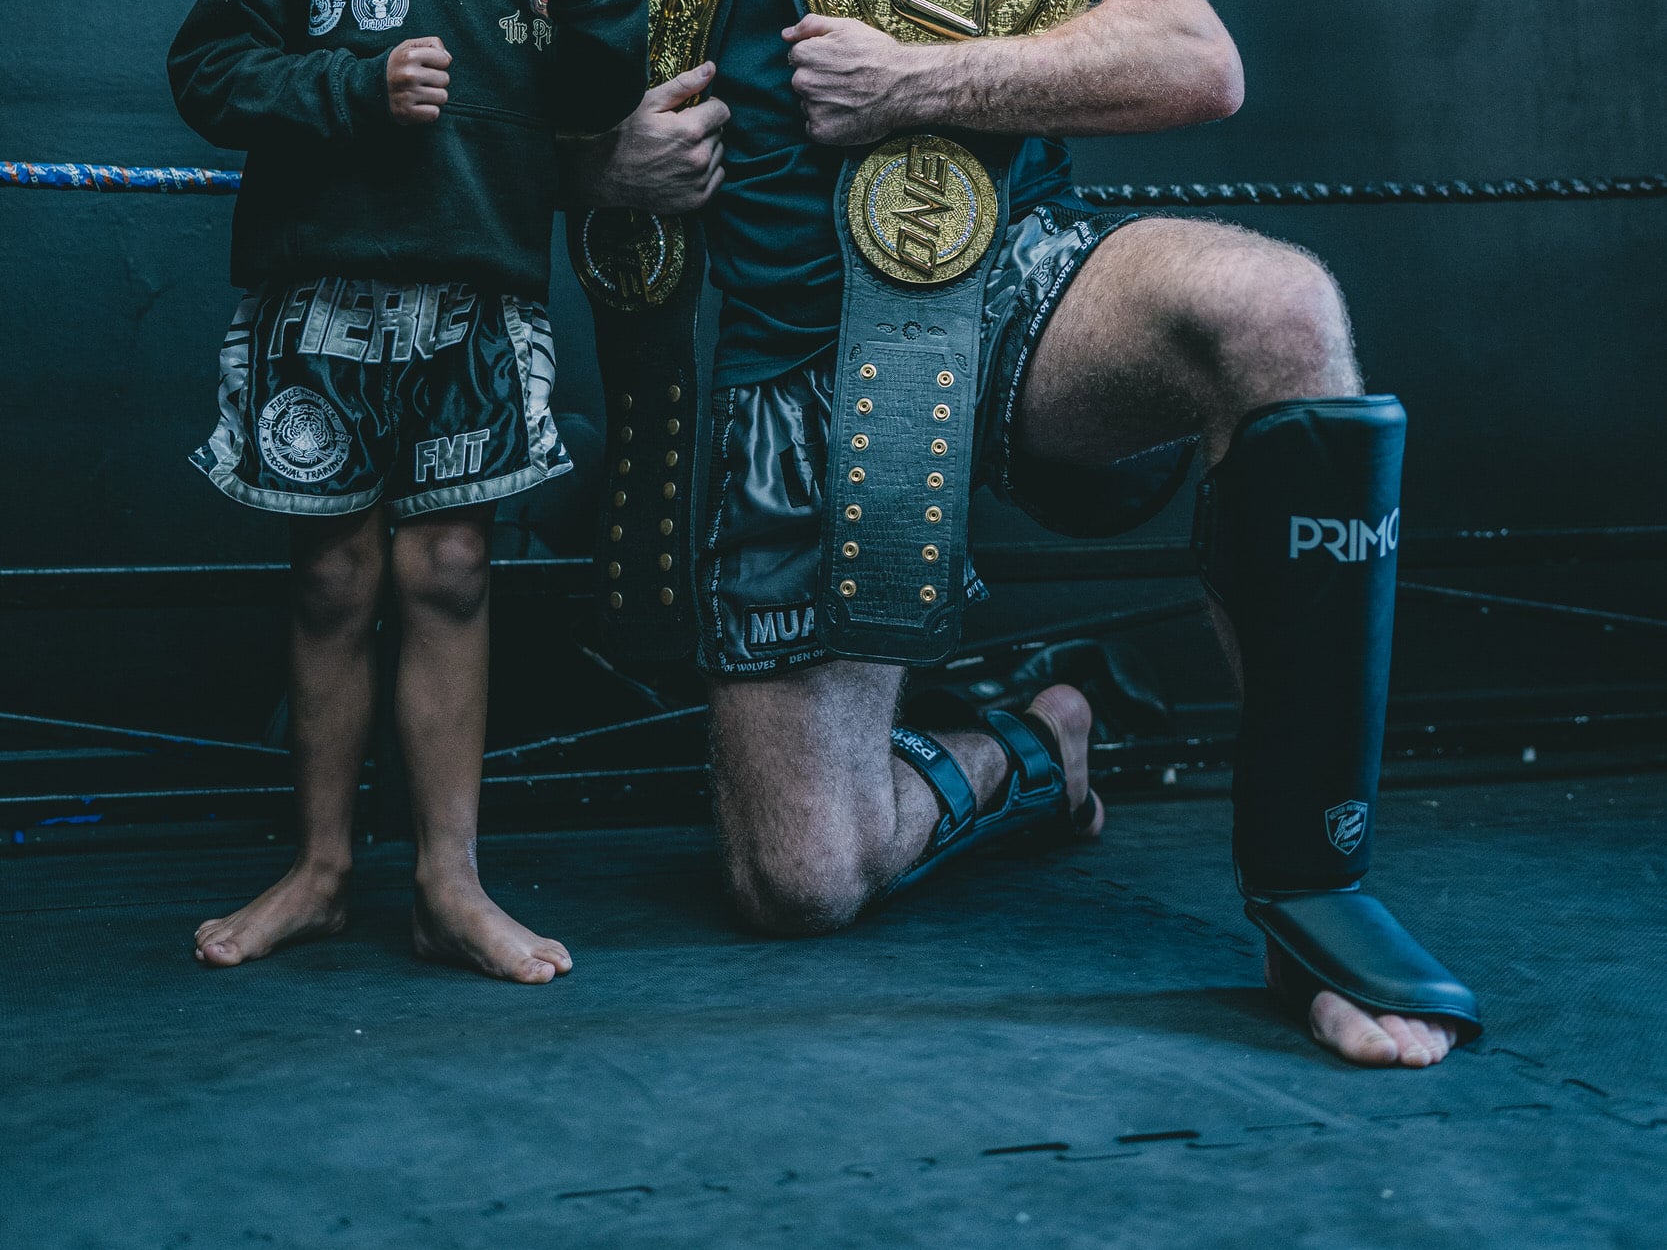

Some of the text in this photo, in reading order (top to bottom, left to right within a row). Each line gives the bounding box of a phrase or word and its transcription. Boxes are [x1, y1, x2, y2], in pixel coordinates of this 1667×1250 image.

[332, 0, 347, 9] 2017
[498, 9, 528, 45] The
[890, 144, 954, 276] ONE
[1029, 259, 1075, 337] DEN OF WOLVES
[266, 277, 478, 364] FIERCE
[269, 388, 300, 411] FIERCE
[264, 447, 345, 480] PERSONAL TRAINING
[414, 428, 491, 483] FMT
[1289, 507, 1399, 562] PRIMO
[750, 606, 815, 645] MUA
[724, 661, 736, 672] OF
[736, 659, 777, 673] WOLVES
[789, 651, 812, 665] DEN
